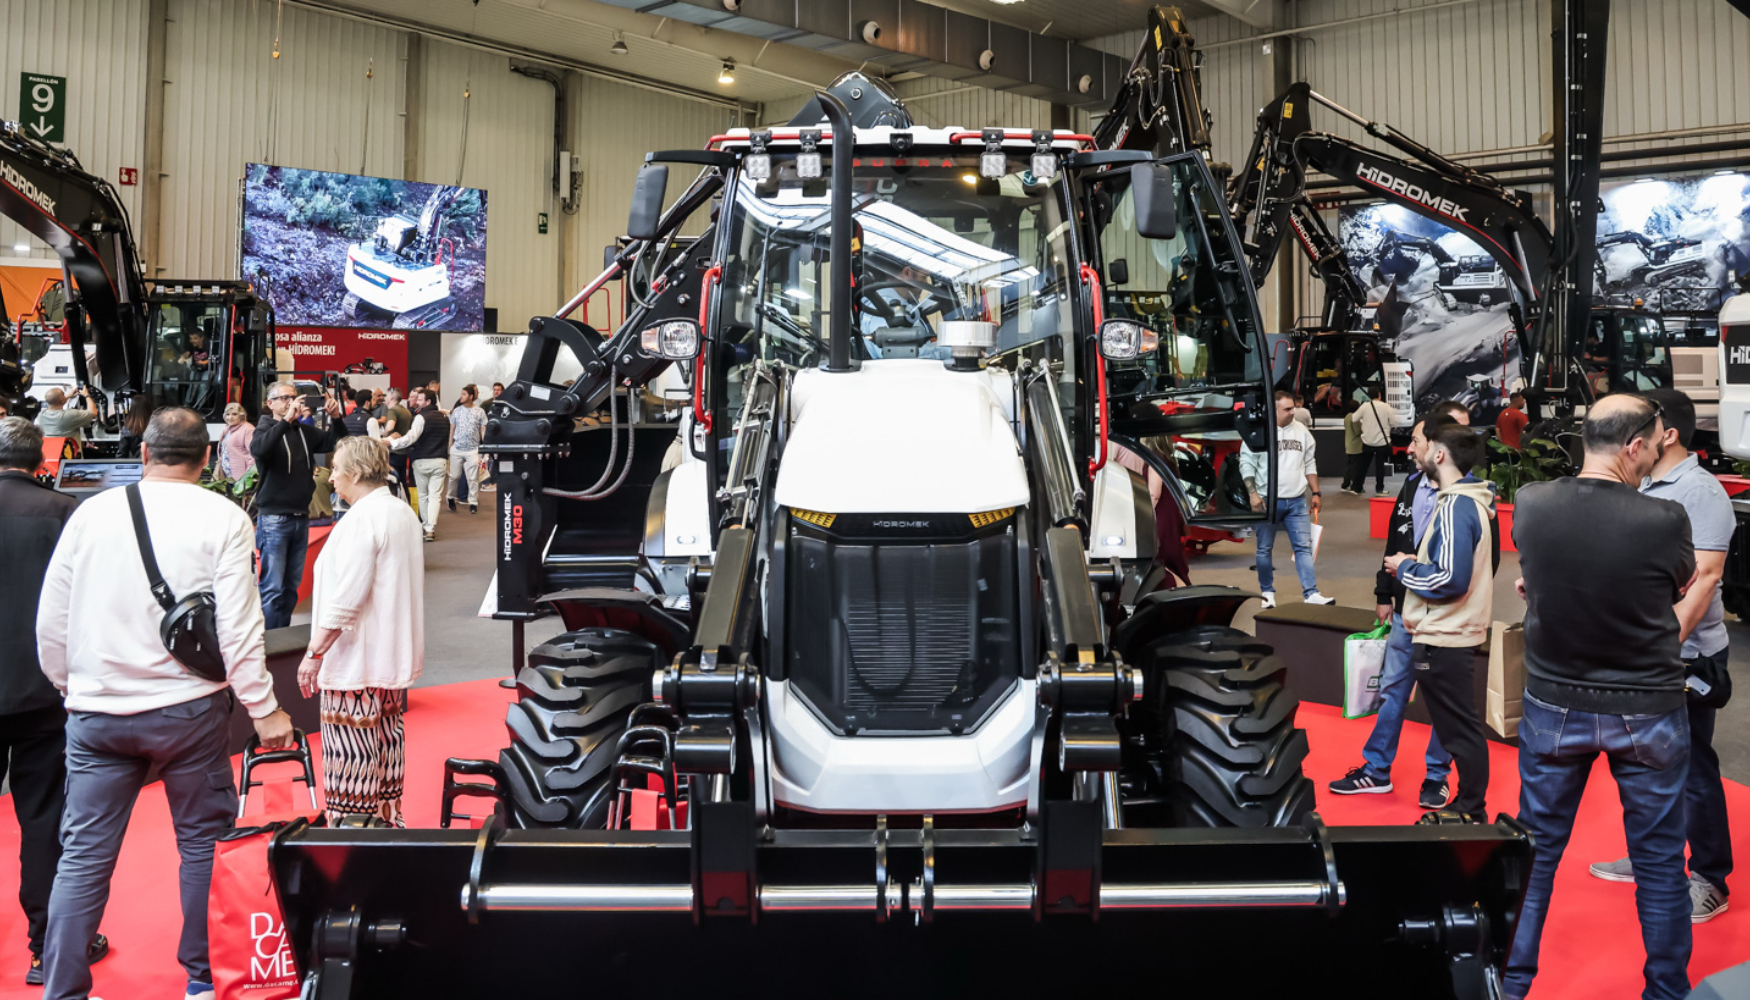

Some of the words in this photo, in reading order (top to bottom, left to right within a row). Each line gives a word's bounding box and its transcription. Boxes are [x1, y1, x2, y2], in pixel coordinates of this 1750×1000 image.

[31, 83, 55, 113] 9
[291, 331, 323, 343] alianza
[512, 505, 523, 545] M30
